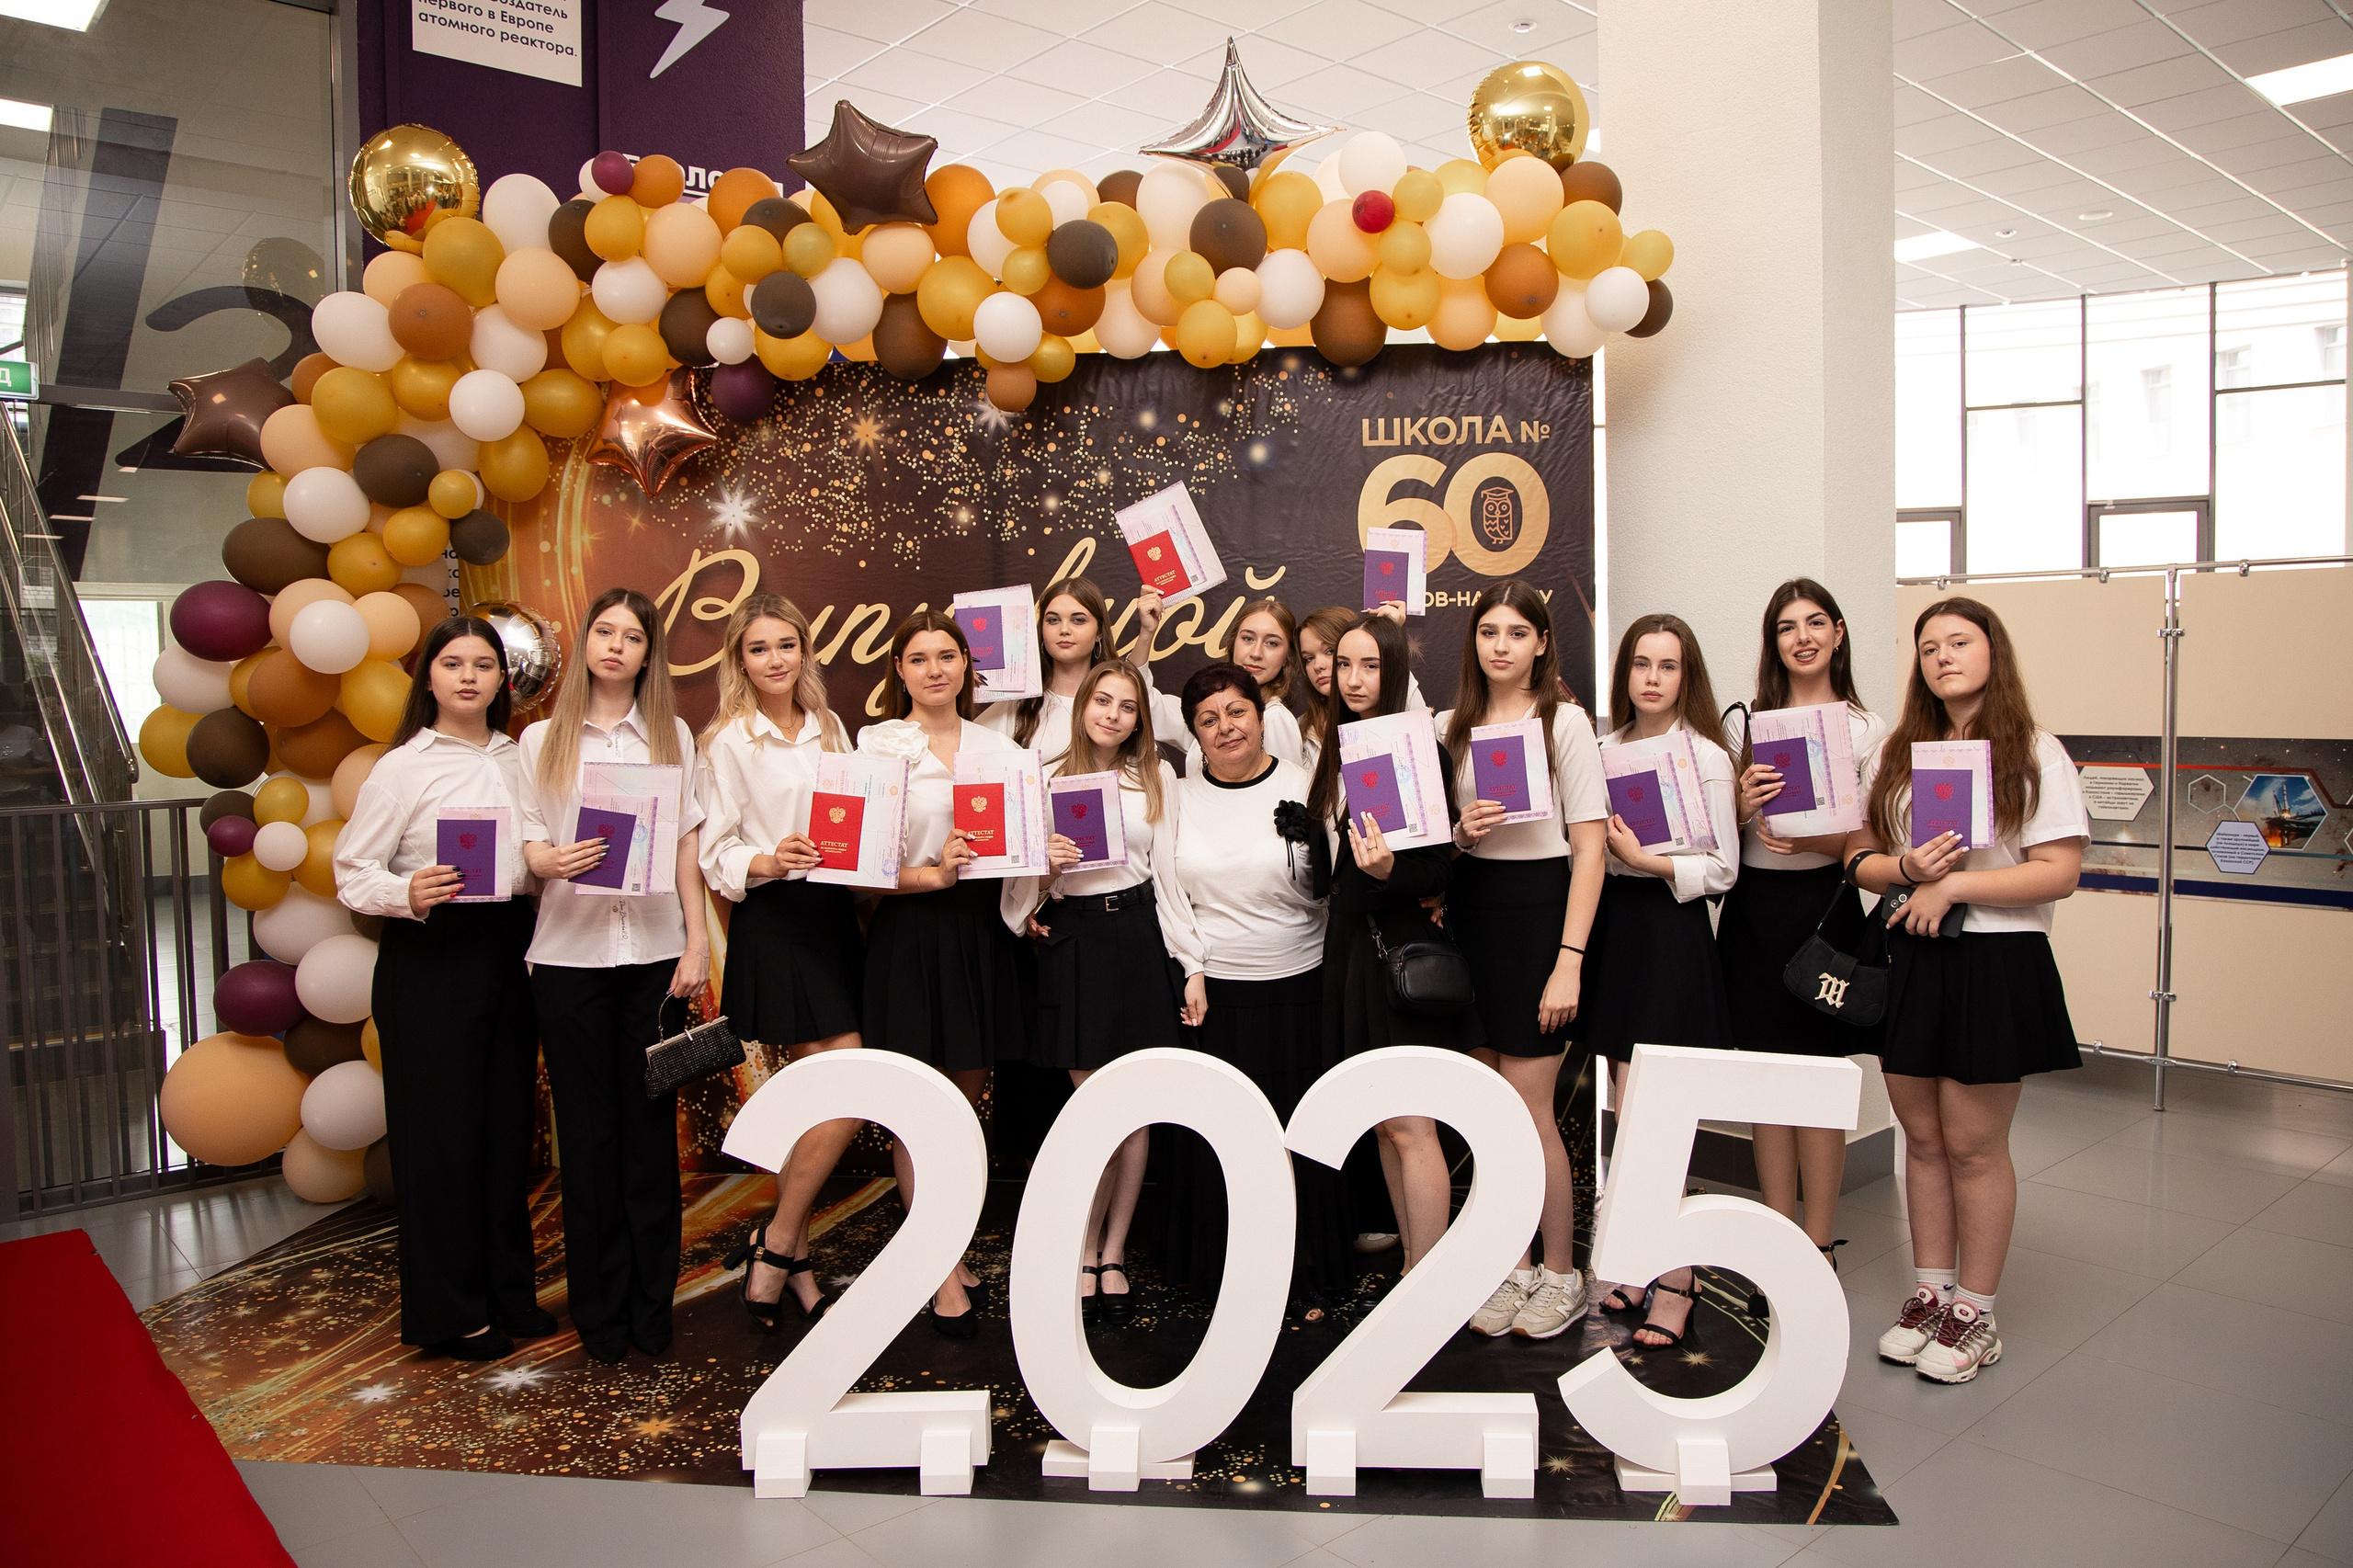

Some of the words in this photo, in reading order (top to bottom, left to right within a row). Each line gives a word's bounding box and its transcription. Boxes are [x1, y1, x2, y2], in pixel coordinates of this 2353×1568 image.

[418, 12, 495, 39] атомного
[500, 30, 577, 57] реактора.
[488, 9, 495, 20] в
[500, 10, 554, 33] Европе
[1362, 415, 1514, 447] ШКОЛА
[1520, 420, 1551, 443] №
[1358, 452, 1551, 576] 60
[722, 1044, 1863, 1476] 2025
